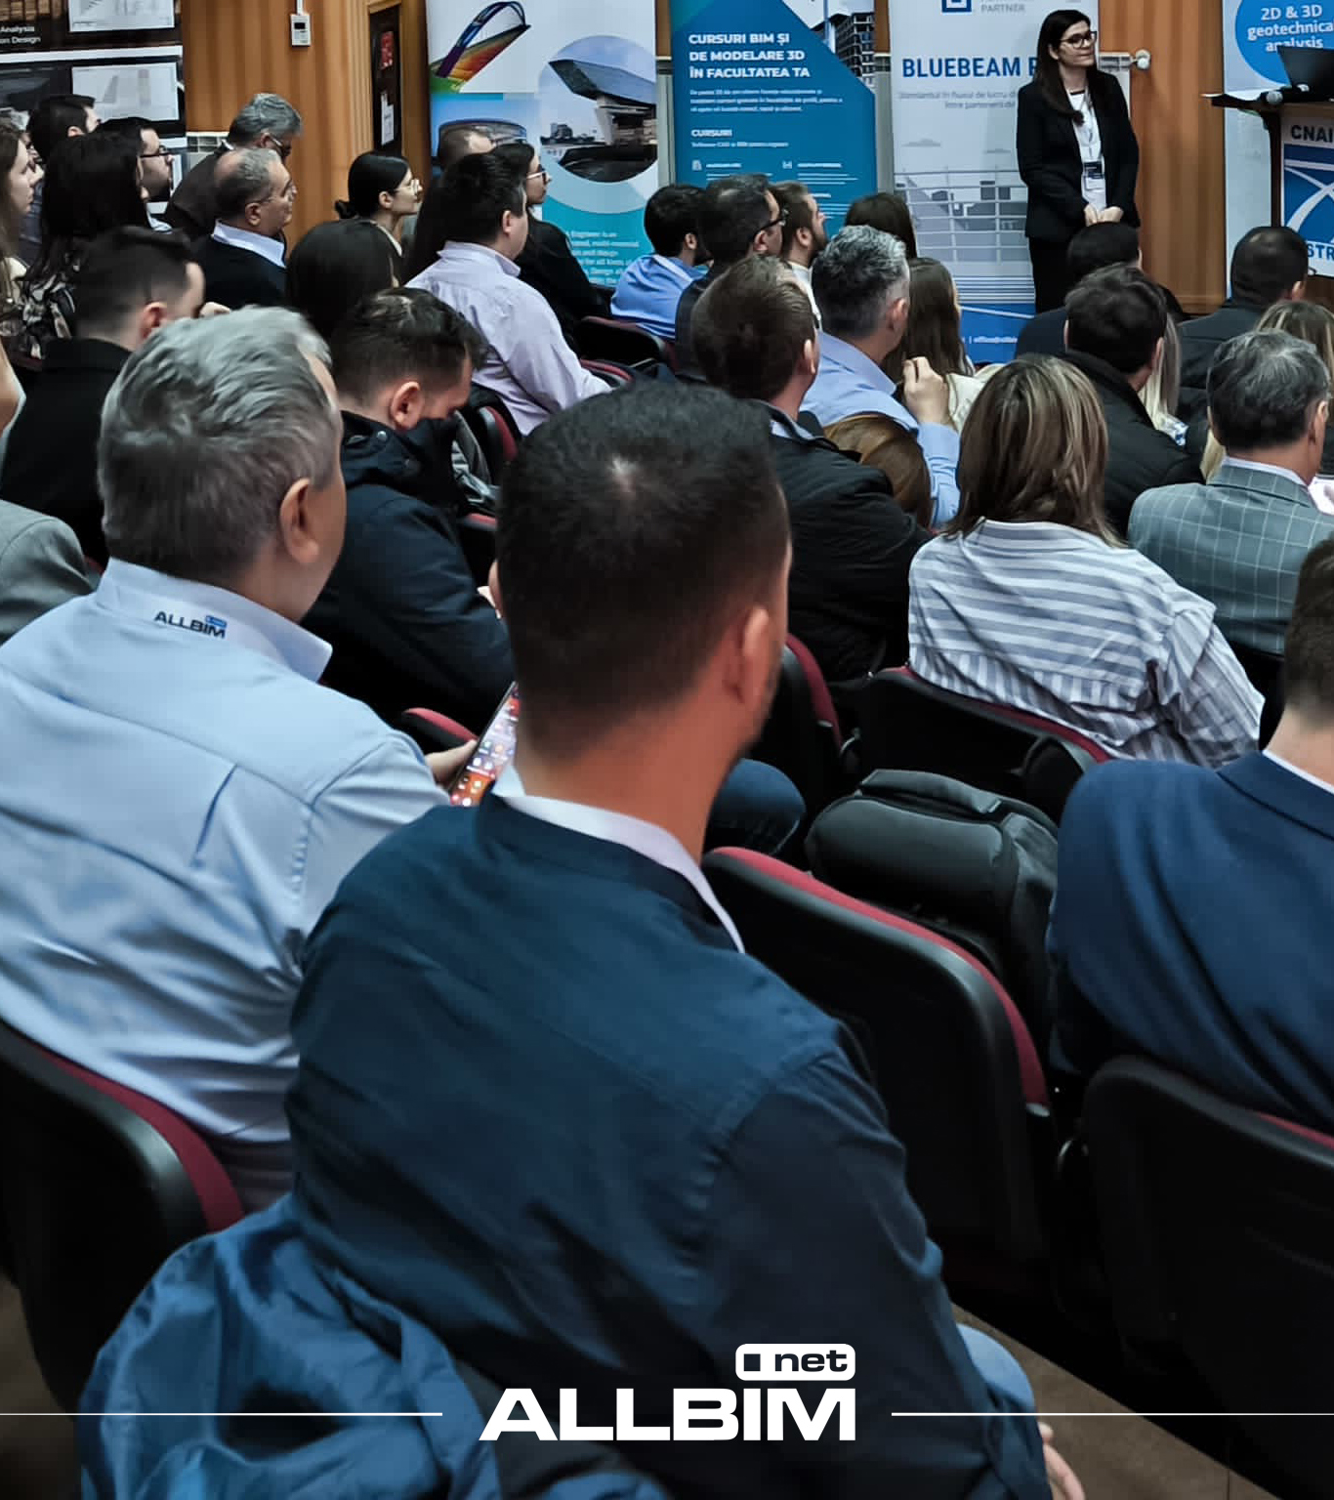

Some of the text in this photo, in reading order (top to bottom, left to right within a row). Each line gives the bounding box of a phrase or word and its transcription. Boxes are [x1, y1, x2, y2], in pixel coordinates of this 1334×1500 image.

[980, 3, 1026, 13] PARTNER
[1260, 3, 1323, 20] 2D & 3D
[0, 24, 35, 36] Analysis
[12, 35, 42, 46] Design
[688, 32, 747, 45] CURSURI
[749, 32, 775, 44] BIM
[689, 50, 806, 62] DE MODELARE 3D
[689, 65, 811, 79] ÎN FACULTATEA TA
[902, 56, 1022, 78] BLUEBEAM
[154, 610, 226, 640] ALLBIM
